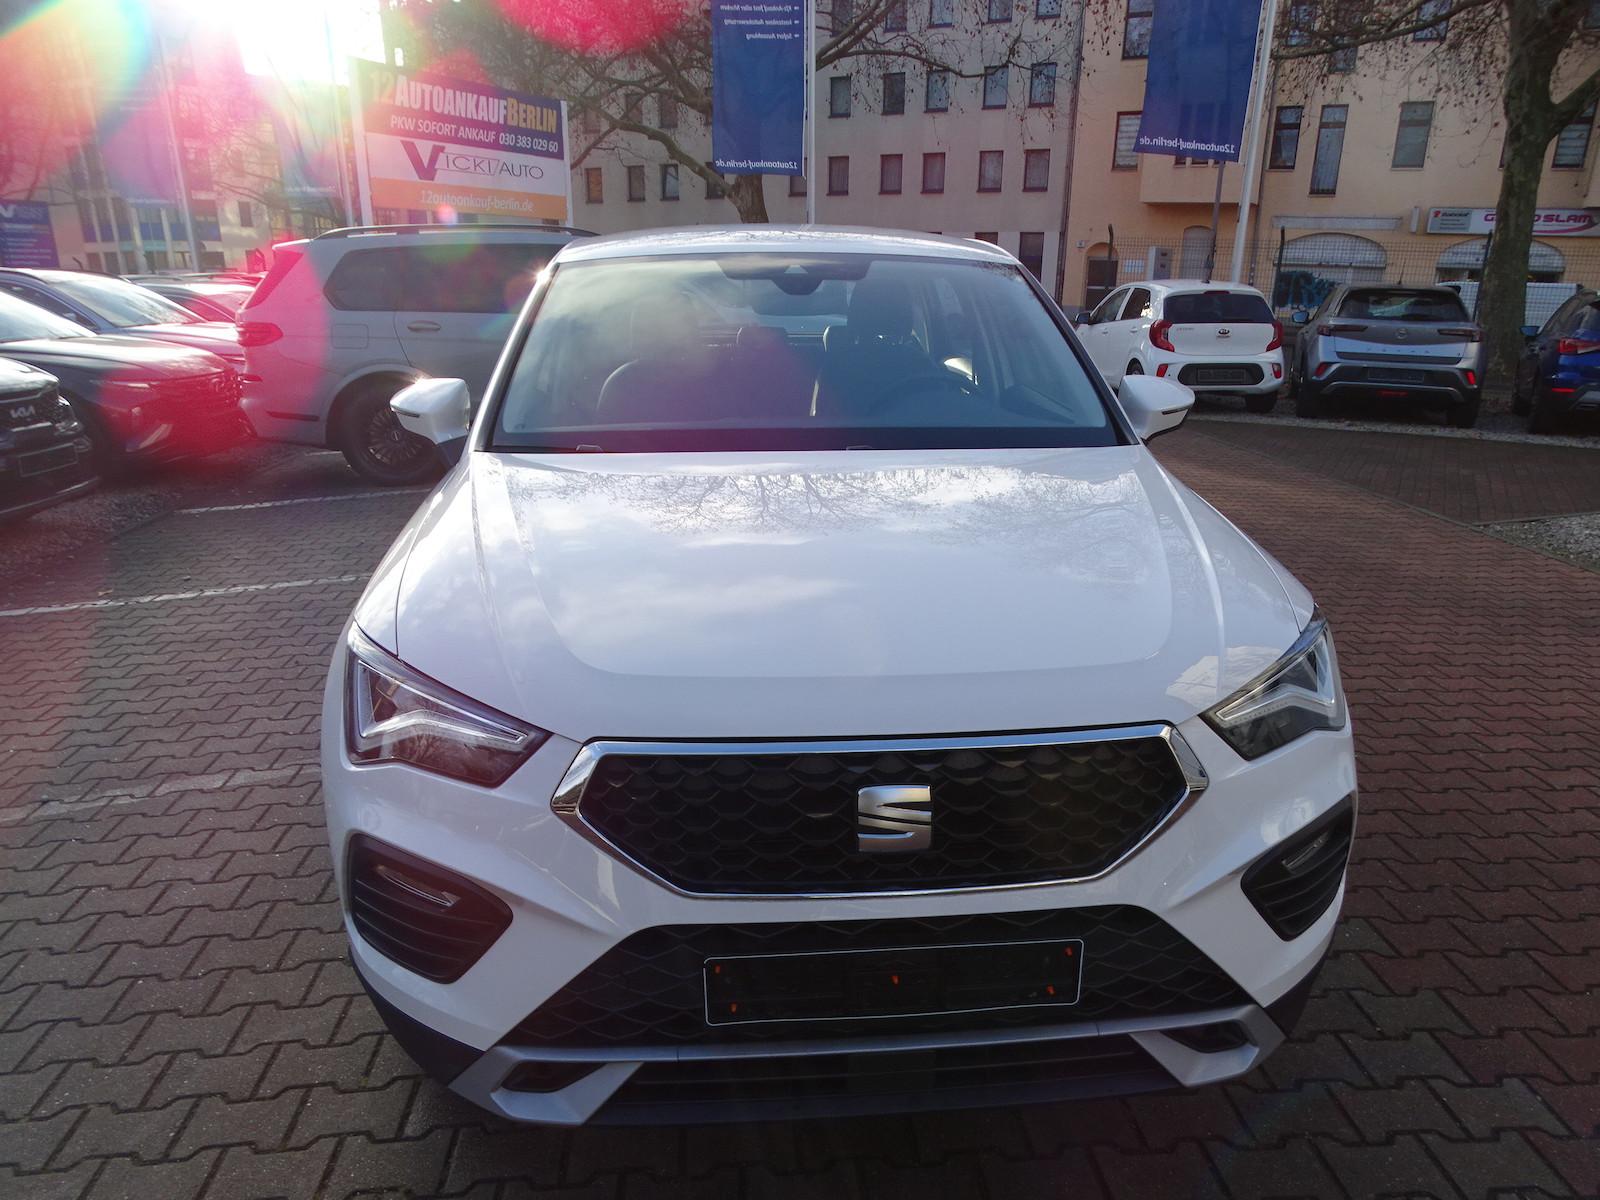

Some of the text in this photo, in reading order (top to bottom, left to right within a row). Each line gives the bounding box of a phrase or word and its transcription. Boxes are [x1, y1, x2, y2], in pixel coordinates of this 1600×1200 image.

[390, 114, 559, 153] PKW SOFORT ANKAUF 030 383 029 60
[1542, 213, 1592, 223] SLAM
